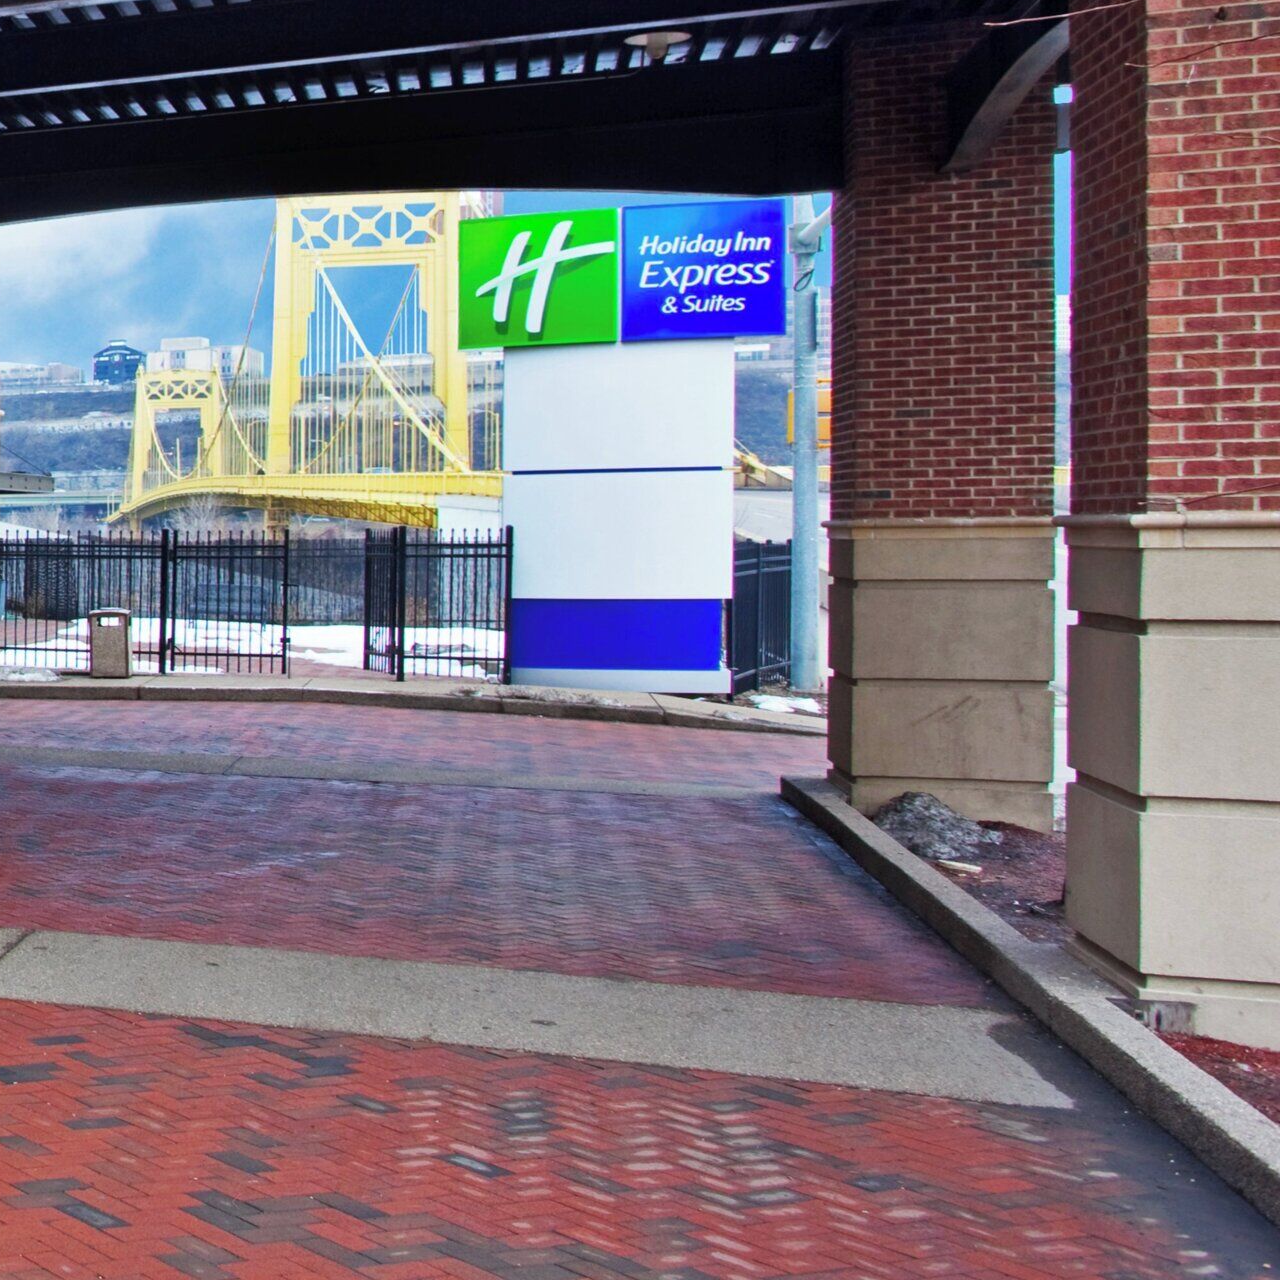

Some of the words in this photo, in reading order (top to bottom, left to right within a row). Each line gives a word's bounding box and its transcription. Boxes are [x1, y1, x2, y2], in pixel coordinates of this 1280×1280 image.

[638, 232, 732, 256] Holiday
[733, 231, 771, 252] Inn
[638, 260, 771, 294] Express
[661, 296, 679, 314] &
[682, 294, 746, 313] Suites
